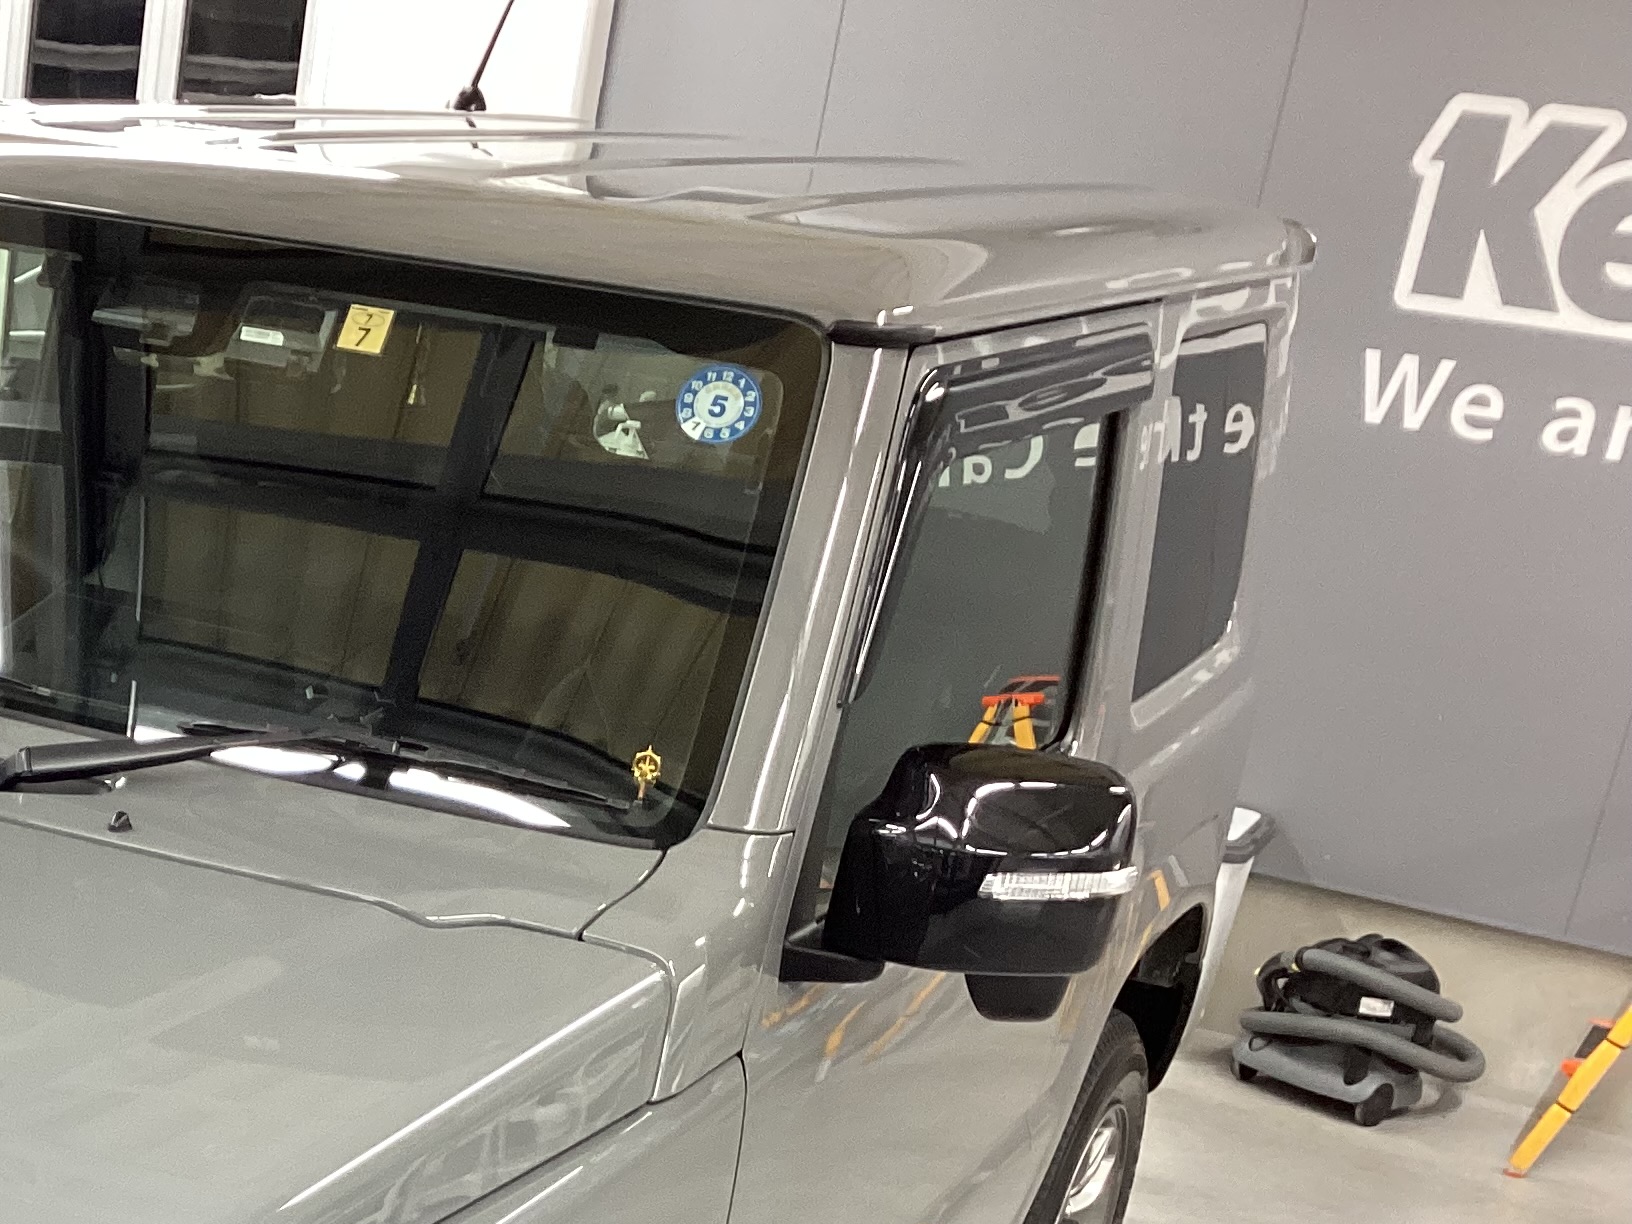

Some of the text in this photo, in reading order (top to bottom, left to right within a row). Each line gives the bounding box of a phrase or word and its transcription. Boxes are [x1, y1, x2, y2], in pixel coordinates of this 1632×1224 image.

[355, 326, 371, 347] 7
[707, 394, 728, 417] 5
[1364, 347, 1505, 442] We
